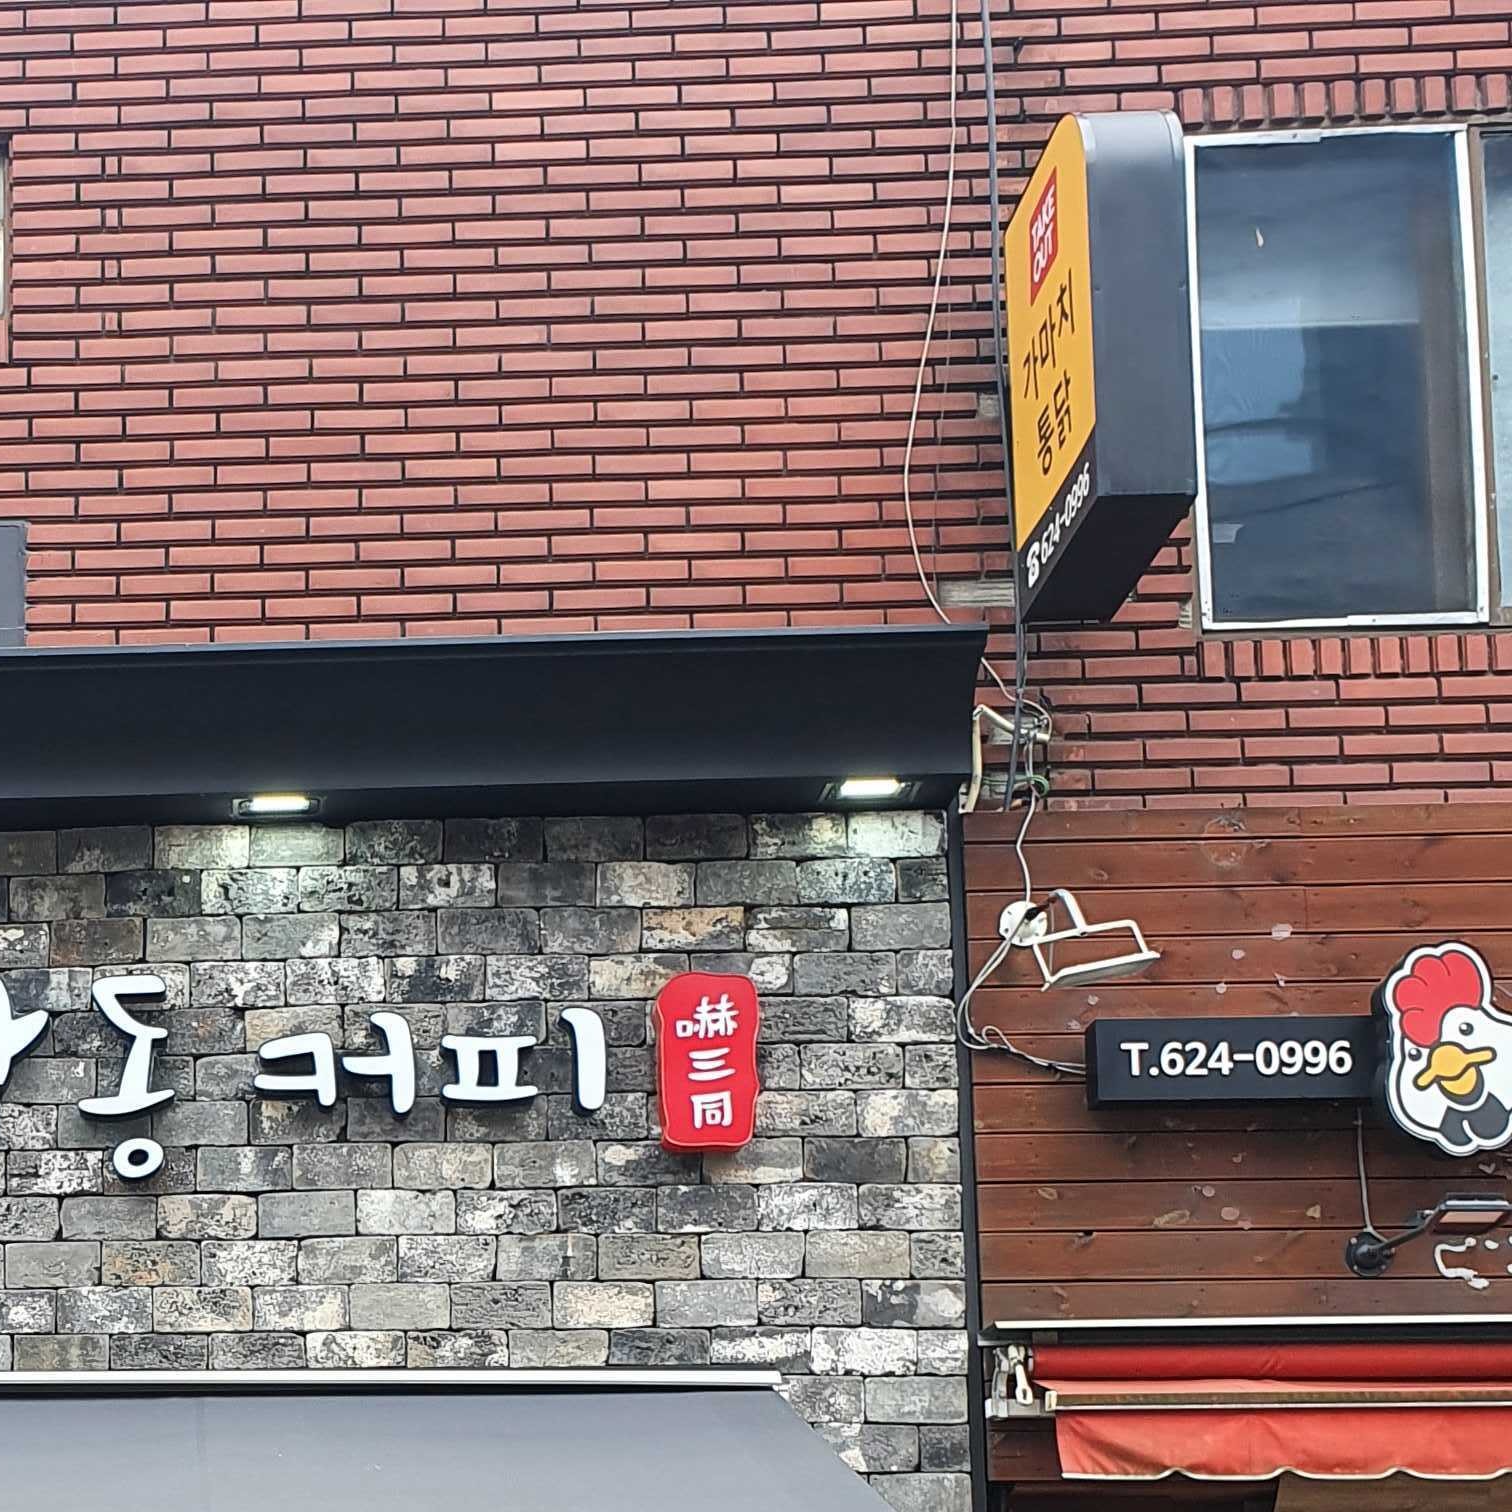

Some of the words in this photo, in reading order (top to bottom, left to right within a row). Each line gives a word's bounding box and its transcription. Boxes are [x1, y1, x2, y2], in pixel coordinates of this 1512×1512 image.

[1031, 183, 1056, 253] TAKE
[1033, 220, 1054, 283] OUT
[1023, 268, 1075, 400] 가마치
[1037, 373, 1072, 476] 통닭
[1040, 461, 1090, 566] 624-0996
[255, 1006, 608, 1117] 커피
[1119, 1039, 1354, 1077] T.624-0996
